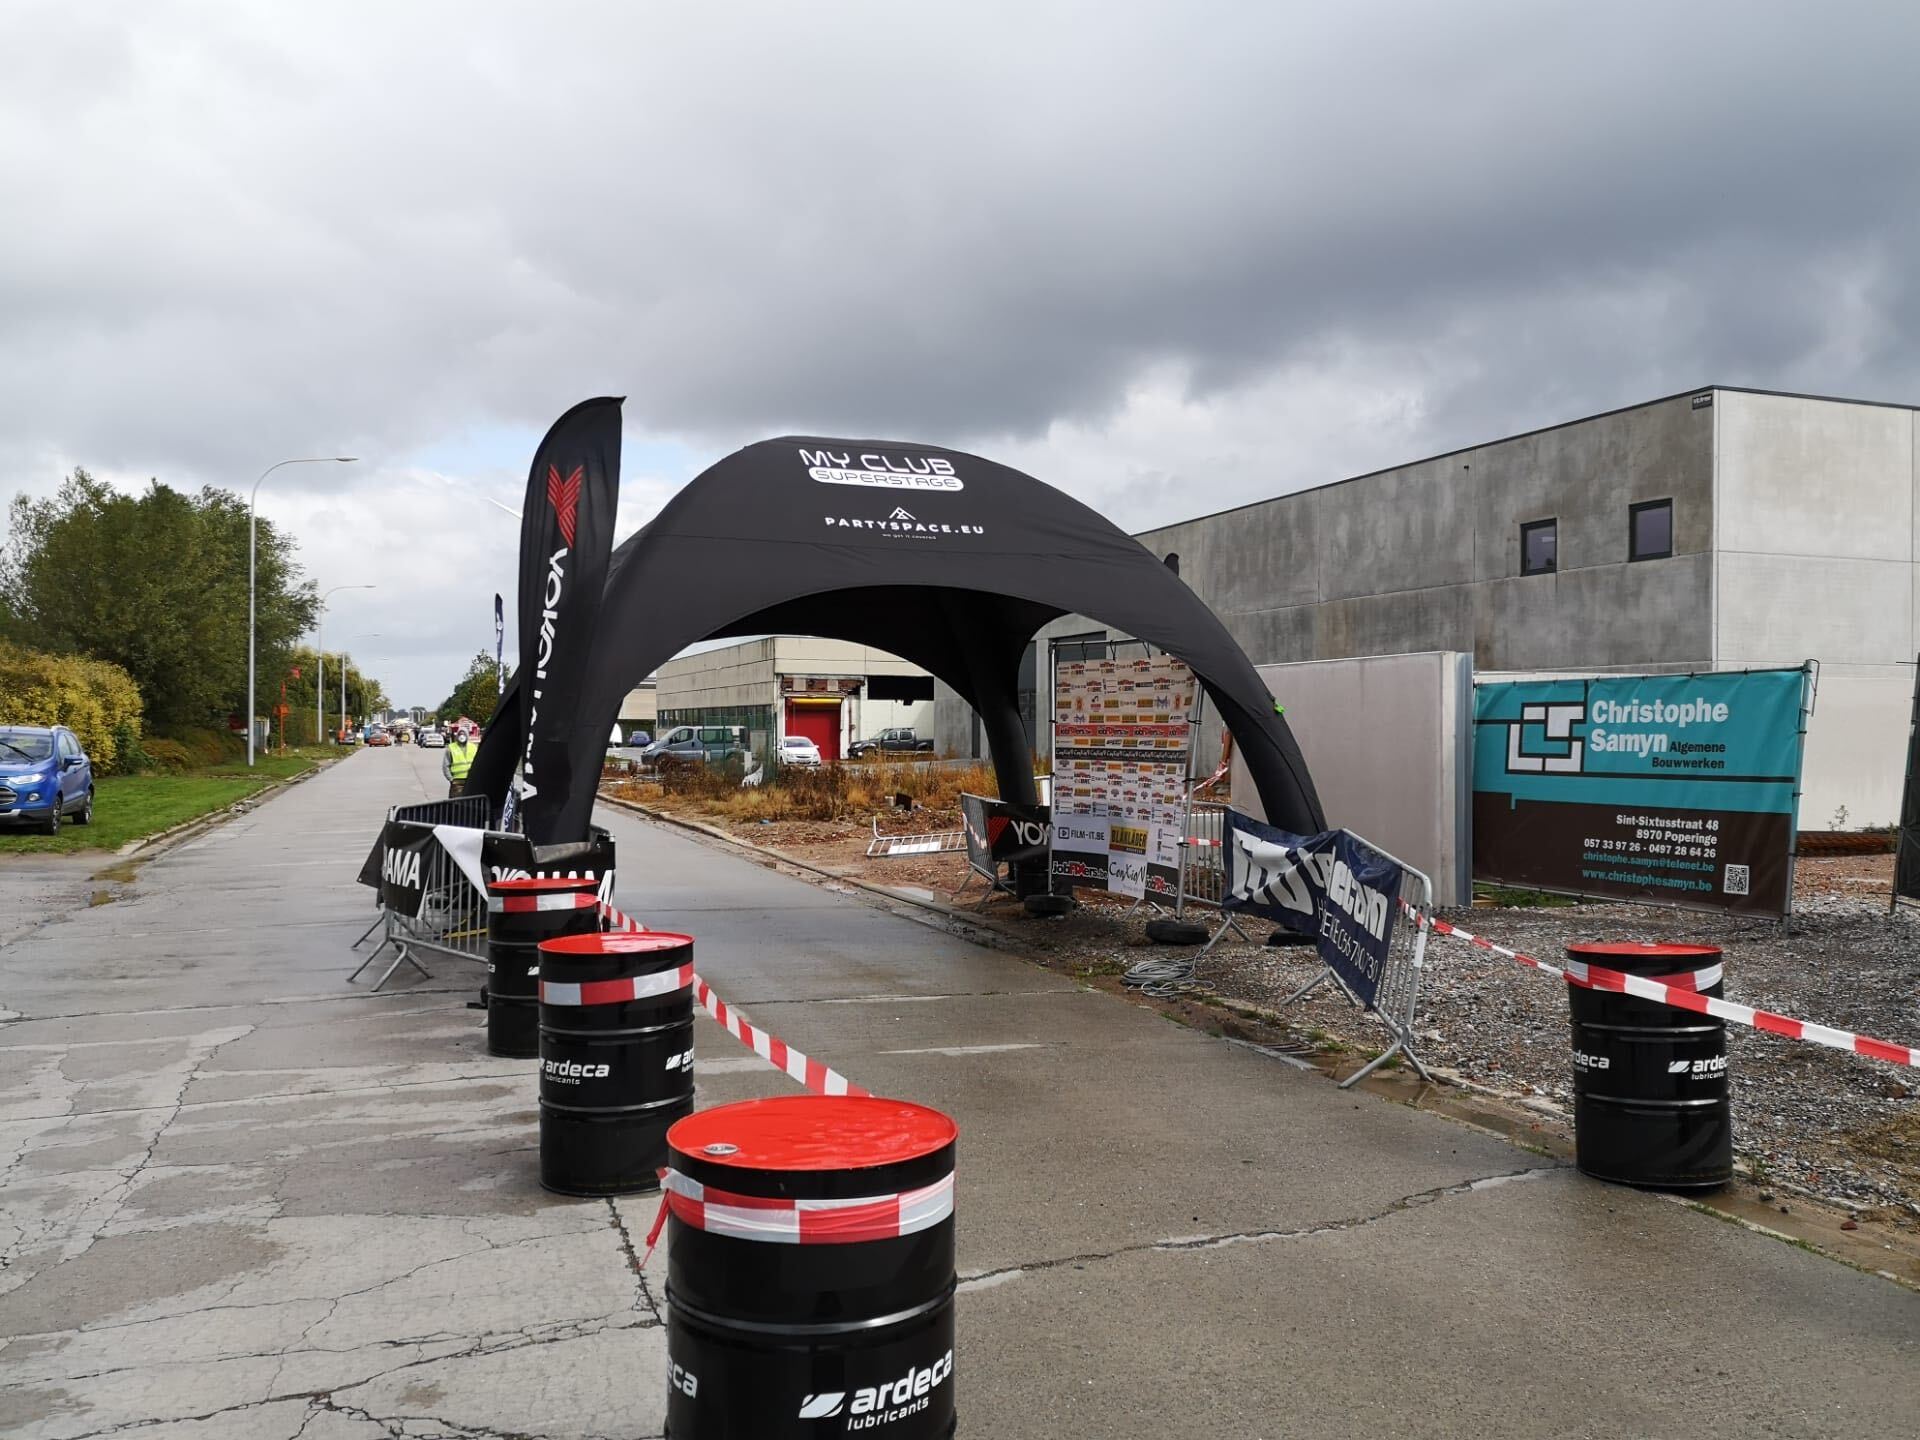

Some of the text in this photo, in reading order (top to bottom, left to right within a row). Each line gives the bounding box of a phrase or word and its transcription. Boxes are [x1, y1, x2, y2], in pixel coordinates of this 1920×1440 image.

[799, 449, 956, 476] MY CLUB
[815, 469, 959, 488] SUPERSTAGE
[824, 516, 985, 535] PARTYSPACE.EU
[520, 547, 568, 801] YOKOA
[1592, 697, 1729, 728] Christophe
[1590, 728, 1668, 758] Samyn
[1669, 741, 1726, 755] Algemene
[1652, 756, 1725, 769] Bouwwerken
[1616, 814, 1719, 831] Sint-Sixtusstraat 48
[1070, 829, 1105, 841] FILM-IT.BE
[1636, 828, 1718, 847] 8970 Poperinge
[1583, 838, 1601, 849] 057
[1602, 840, 1614, 850] 33
[1615, 841, 1627, 851] 97
[1628, 842, 1641, 852] 26
[1649, 844, 1672, 854] 0497
[1674, 846, 1687, 856] 28
[1689, 847, 1701, 857] 64
[1703, 848, 1717, 859] 26
[383, 846, 420, 890] AMA
[1583, 851, 1715, 872] christophe.samyn@telenet.be
[1582, 868, 1713, 892] www.christophesamyn.be
[545, 1059, 610, 1078] ardeca
[850, 1349, 953, 1415] ardeca
[847, 1396, 930, 1431] lubricants
